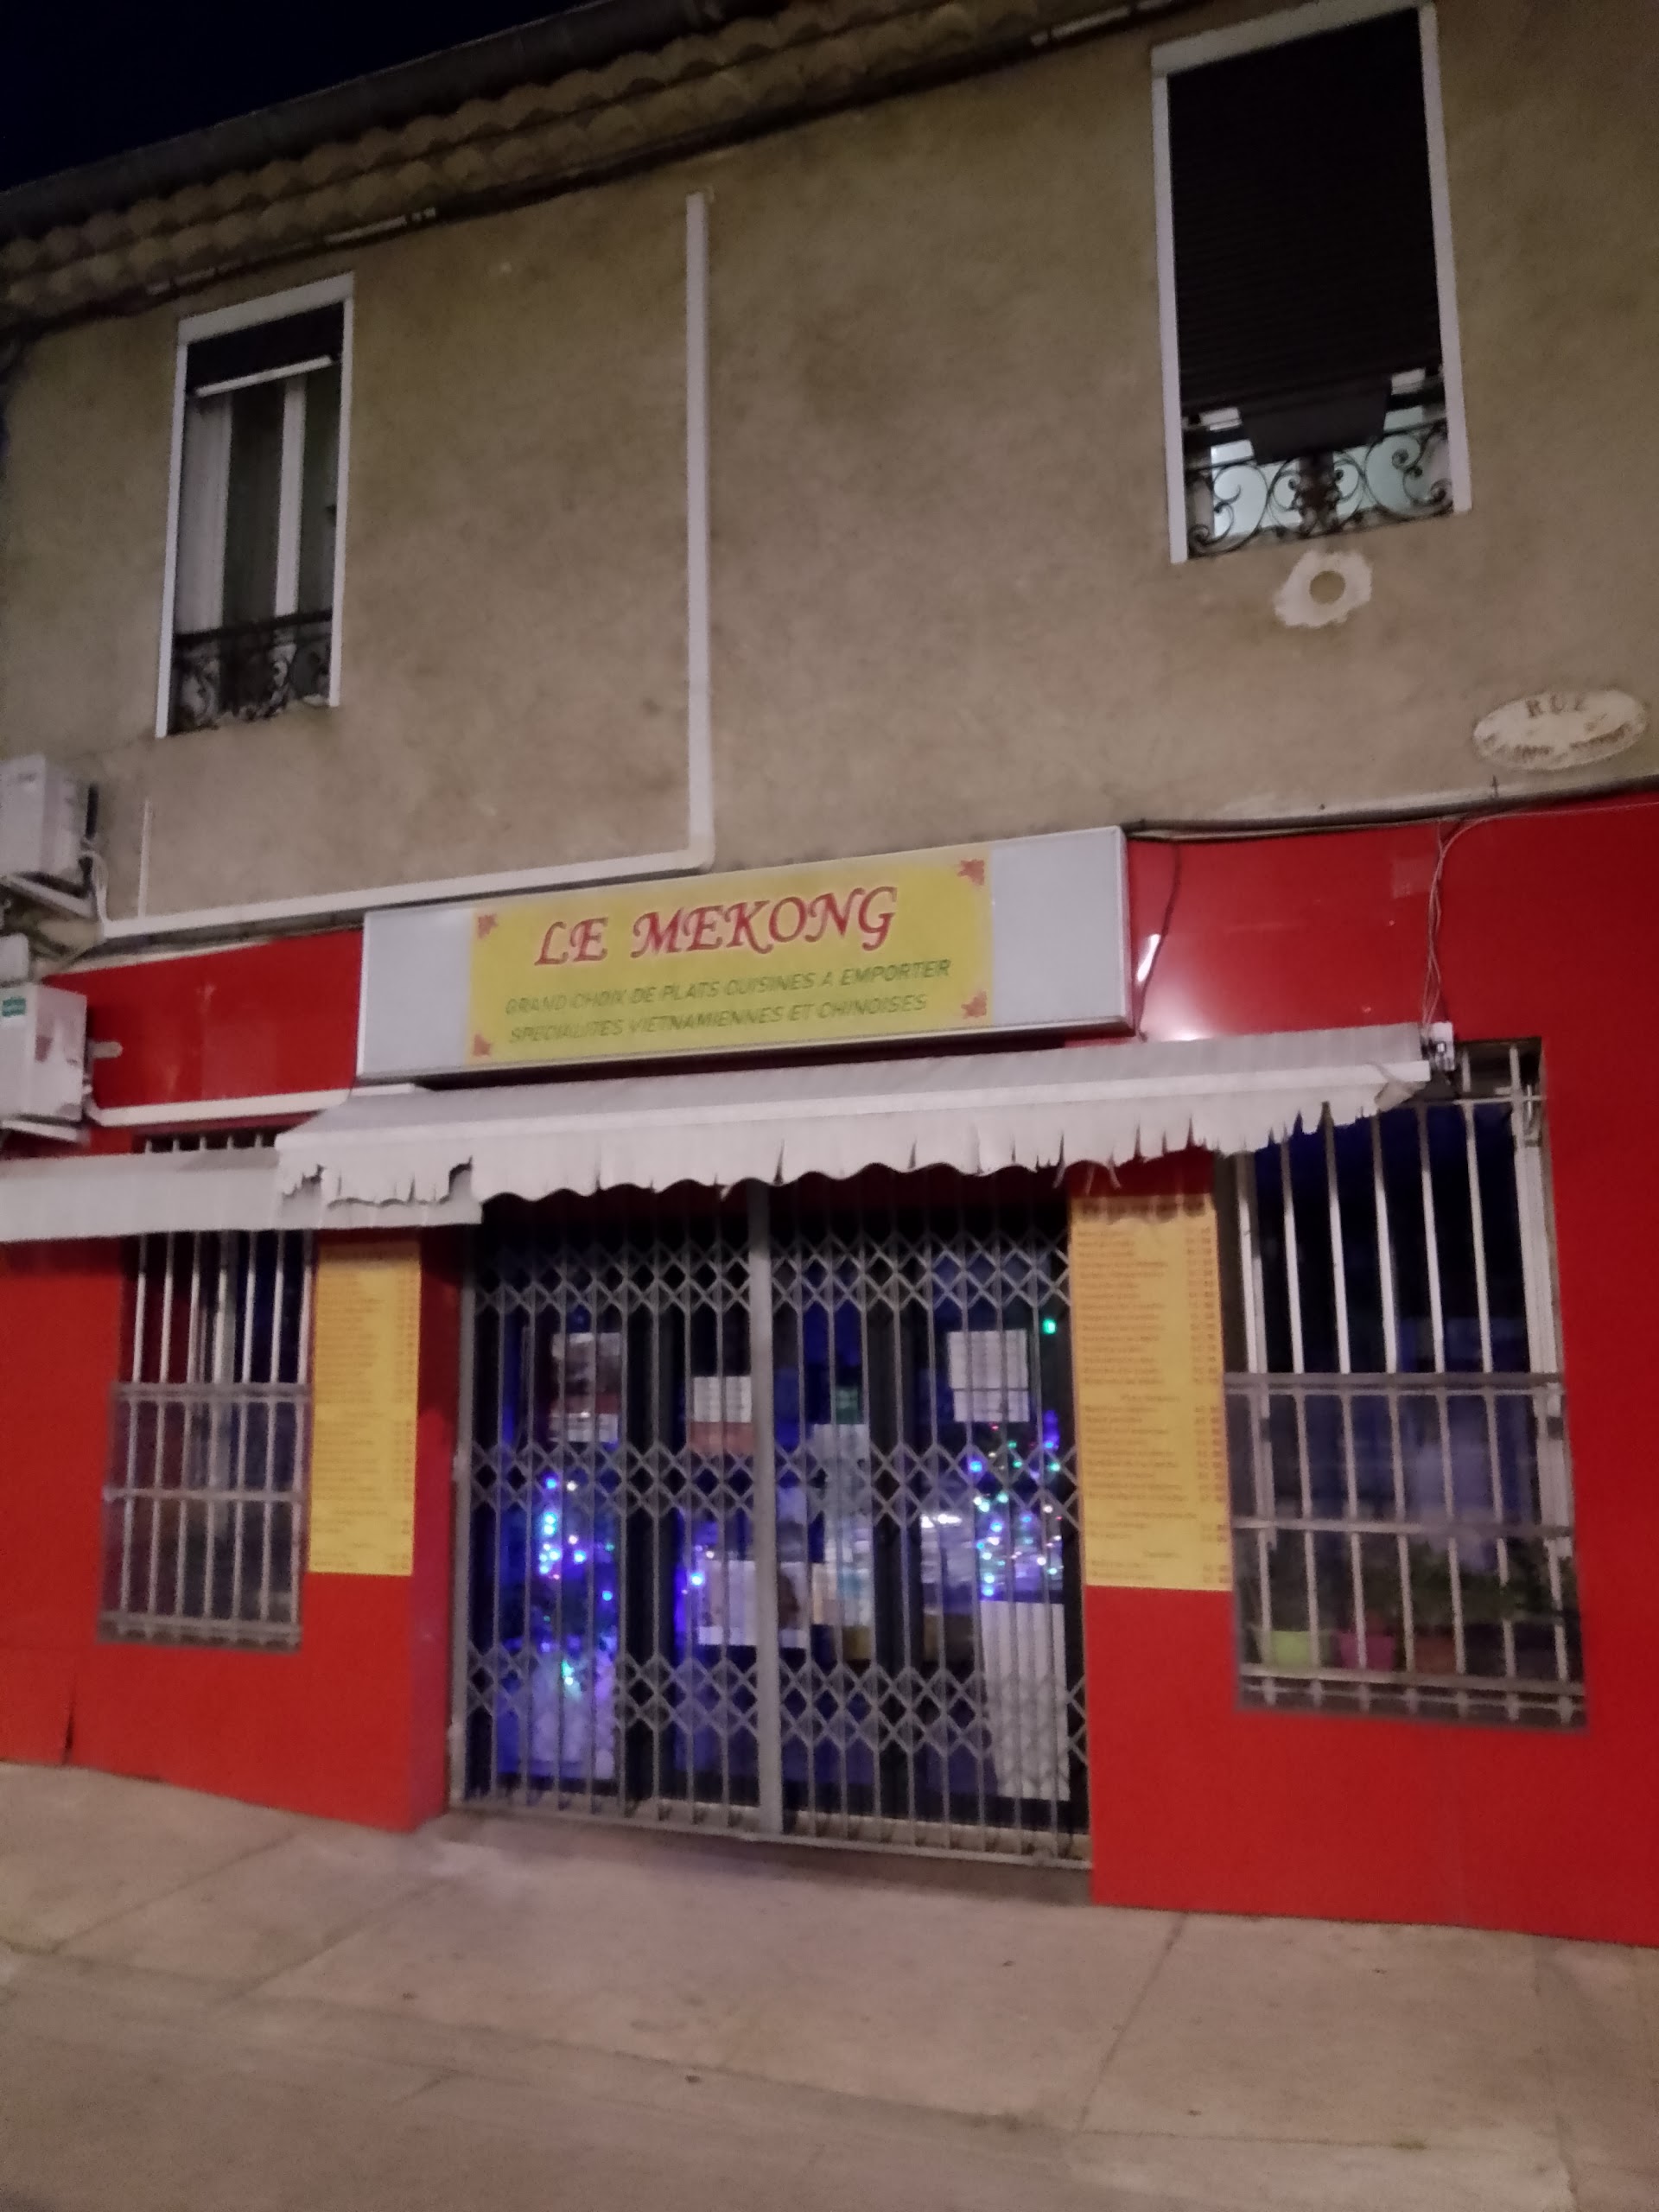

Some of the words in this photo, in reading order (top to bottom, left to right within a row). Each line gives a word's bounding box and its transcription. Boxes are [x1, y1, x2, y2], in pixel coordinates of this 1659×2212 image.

[533, 916, 610, 967] LE
[630, 886, 899, 959] MEKONG
[506, 995, 568, 1014] GRAND
[628, 985, 657, 1005] DE
[661, 981, 721, 1001] PLATS
[840, 957, 952, 987] EMPORTER
[788, 1003, 816, 1021] ET
[817, 993, 928, 1020] CHINOISES
